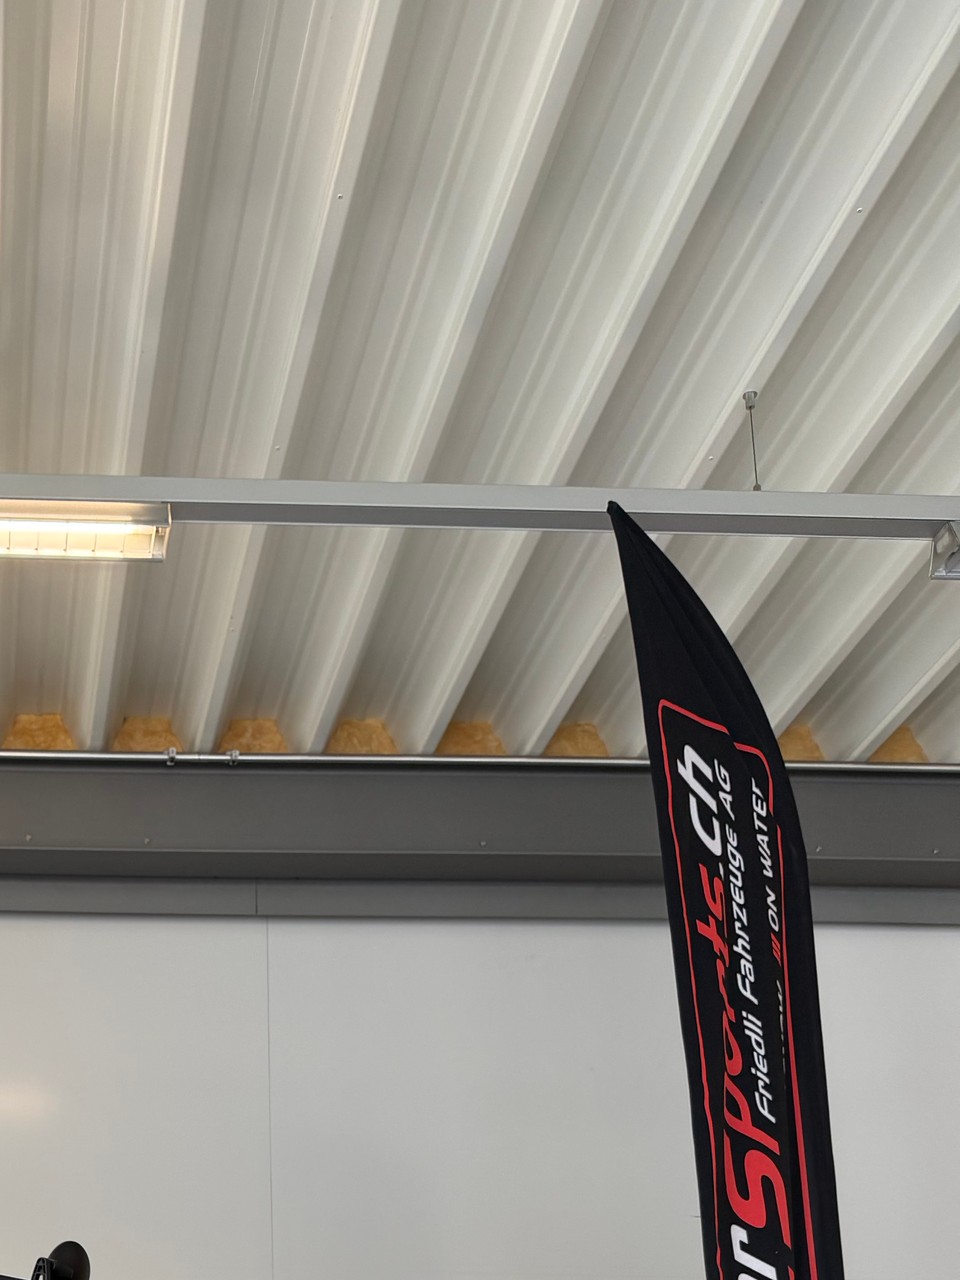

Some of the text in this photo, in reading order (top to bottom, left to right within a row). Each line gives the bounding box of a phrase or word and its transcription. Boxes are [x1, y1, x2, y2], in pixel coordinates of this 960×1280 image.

[713, 758, 736, 822] AG
[765, 885, 780, 932] ON
[741, 1010, 776, 1124] Friedli
